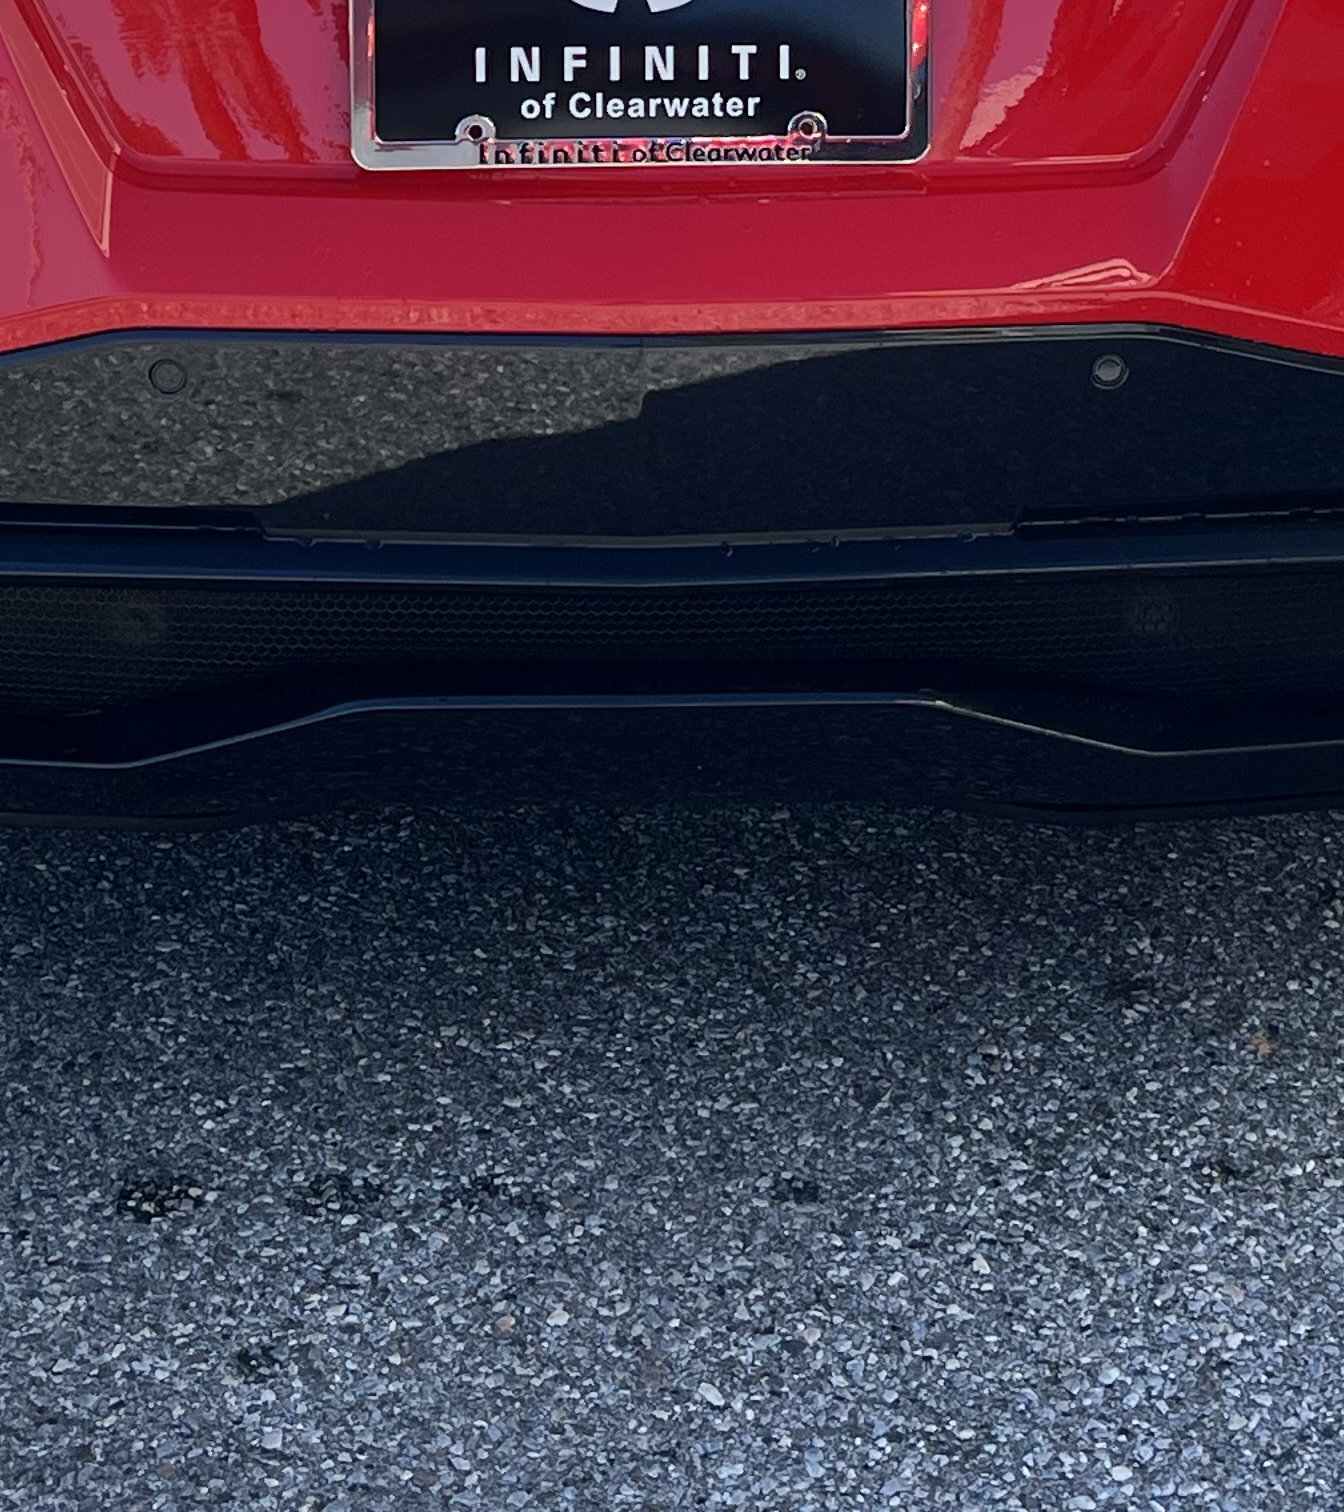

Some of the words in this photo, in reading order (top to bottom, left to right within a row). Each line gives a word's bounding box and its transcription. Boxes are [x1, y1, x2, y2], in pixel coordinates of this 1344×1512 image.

[520, 92, 557, 120] of
[568, 91, 761, 119] Clearwater
[478, 142, 621, 165] Infiniti
[632, 141, 658, 164] of
[664, 140, 812, 164] Clearwater
